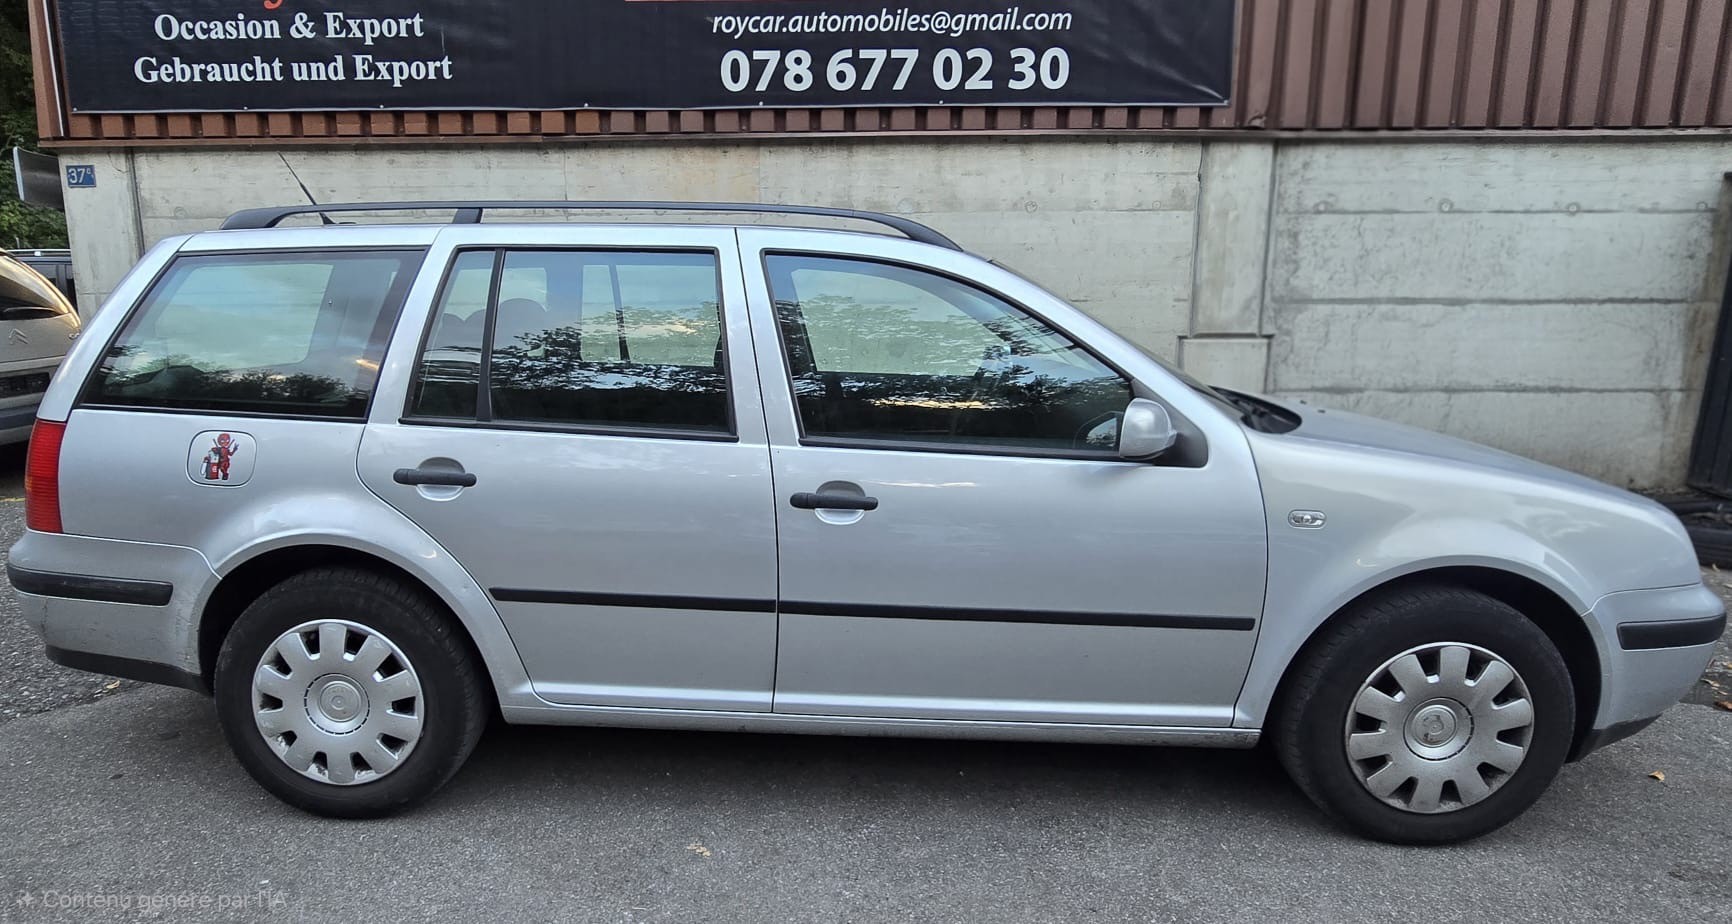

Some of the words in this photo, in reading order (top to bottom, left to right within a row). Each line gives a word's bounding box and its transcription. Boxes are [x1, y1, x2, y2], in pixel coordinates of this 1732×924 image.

[155, 13, 281, 40] Occasion
[290, 13, 316, 38] &
[324, 12, 424, 44] Export
[712, 7, 1072, 38] roycar.automobiles@gmail.com
[135, 56, 283, 82] Gebraucht
[291, 55, 345, 81] und
[352, 55, 452, 87] Export
[721, 50, 813, 91] 078
[827, 49, 918, 90] 677
[933, 48, 992, 90] 02
[1008, 47, 1069, 89] 30
